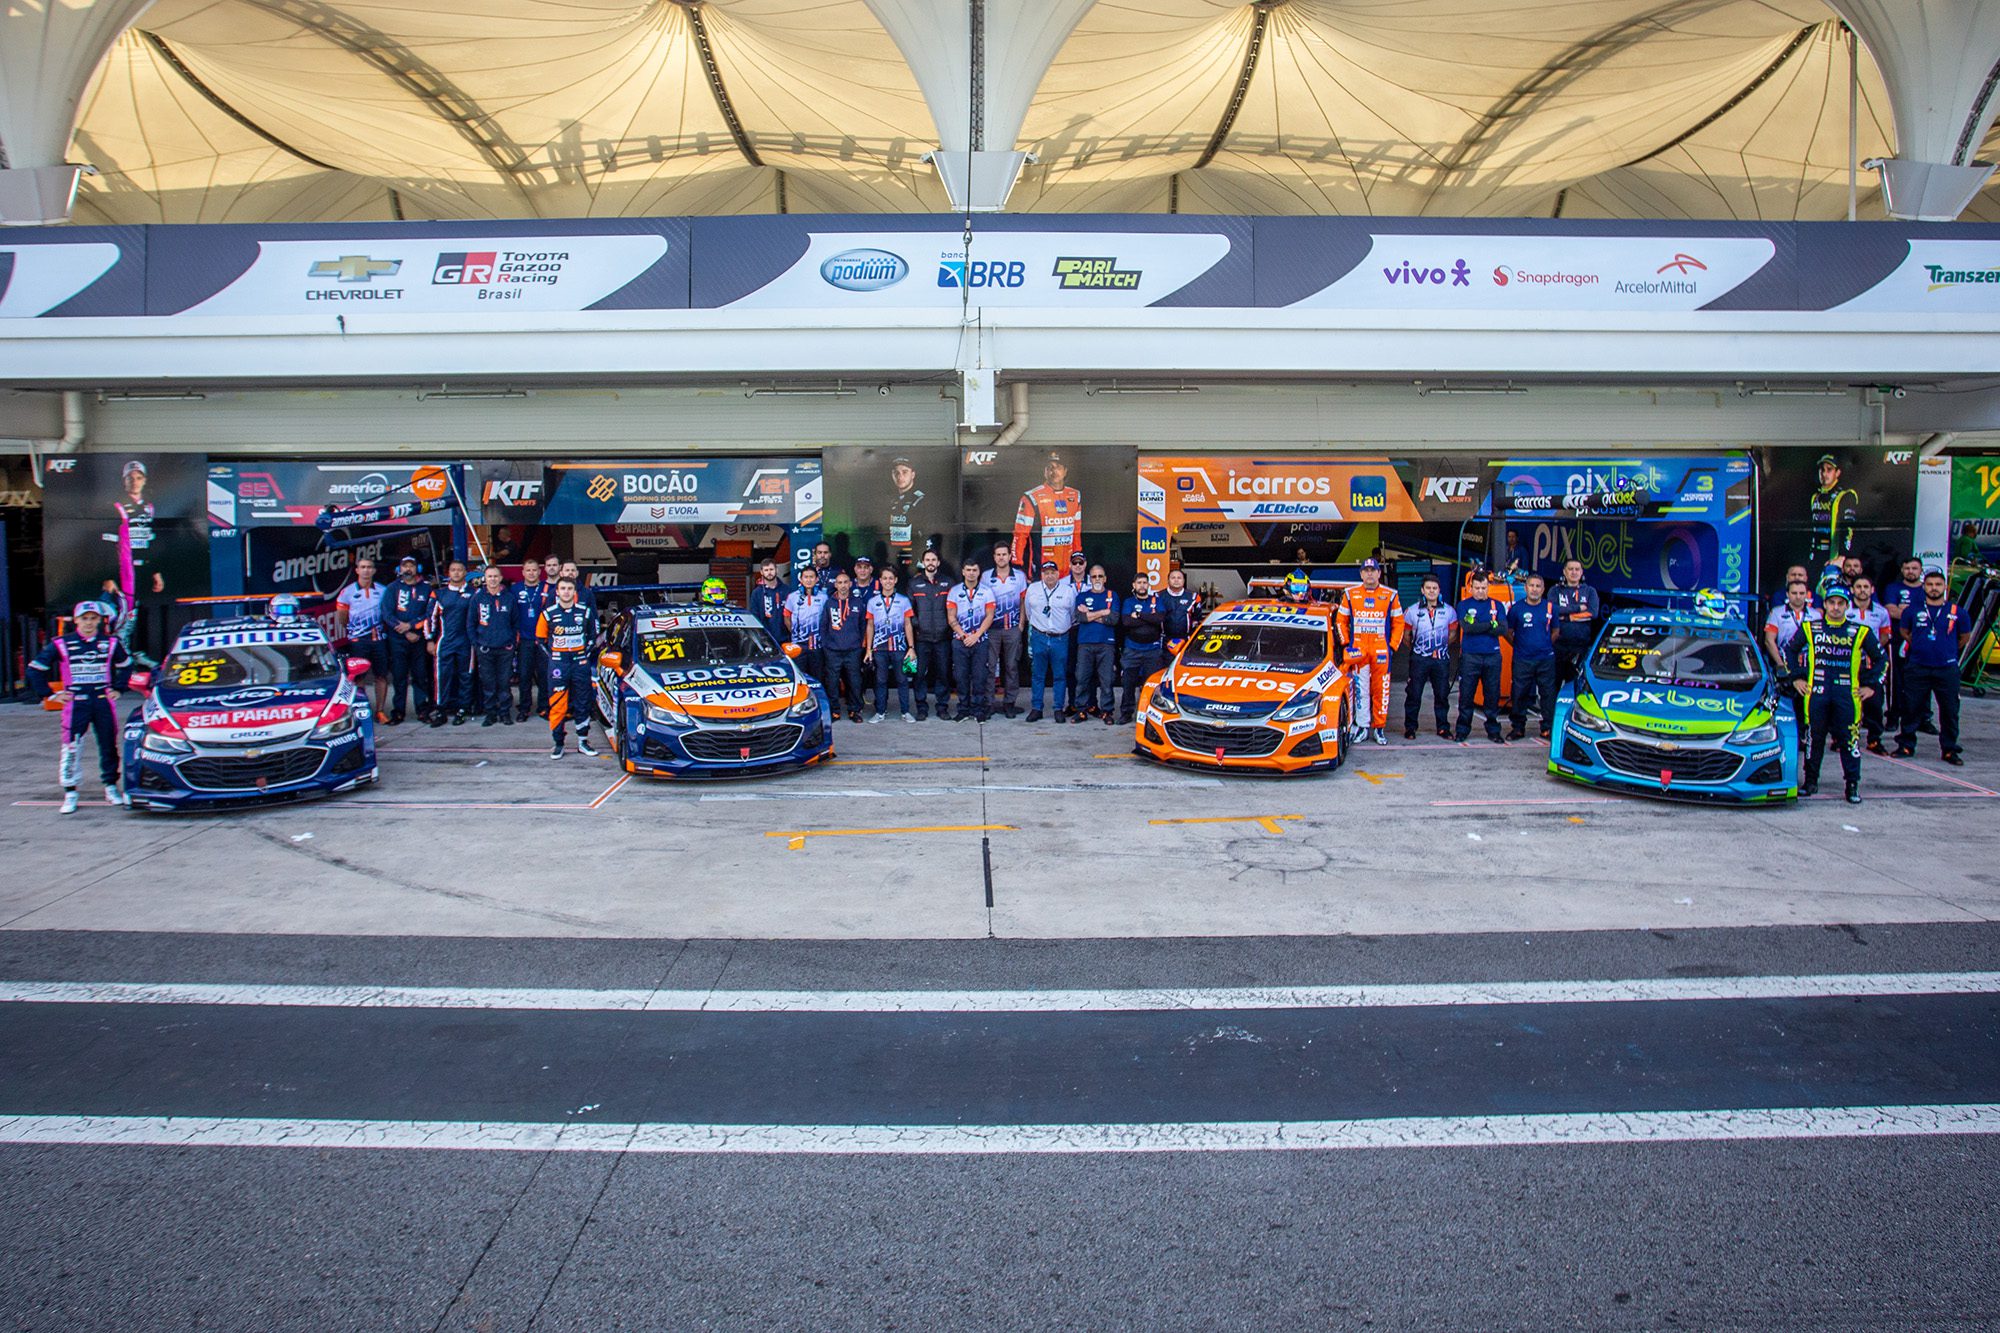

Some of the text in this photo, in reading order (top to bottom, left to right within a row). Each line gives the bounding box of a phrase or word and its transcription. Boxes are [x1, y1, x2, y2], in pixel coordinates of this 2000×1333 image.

[502, 252, 569, 261] TOYOTA
[434, 264, 492, 284] GR
[500, 263, 562, 272] GAZOO
[832, 261, 897, 284] podium
[969, 260, 1026, 288] BRB
[1069, 260, 1112, 274] PARI
[1383, 260, 1446, 285] vivo
[497, 274, 558, 285] Racing
[1076, 273, 1137, 286] MATCH
[1517, 270, 1599, 287] Snapdragon
[305, 288, 404, 301] CHEVROLET
[478, 288, 522, 300] Brasil
[1614, 281, 1697, 294] ArcelorMittal
[965, 451, 998, 465] KTF
[1884, 451, 1913, 465] KTF
[47, 459, 77, 472] KTF
[623, 470, 698, 494] BOCÃO
[758, 478, 790, 494] 121
[1228, 470, 1330, 495] icarros
[1566, 466, 1661, 495] pixbet
[1697, 475, 1714, 491] 3
[238, 482, 270, 497] 85
[482, 480, 543, 506] KTF
[1419, 477, 1478, 502] KTF
[1352, 492, 1385, 508] Itaú
[1514, 495, 1552, 509] icarros
[389, 502, 416, 520] KTF
[668, 506, 699, 515] EVORA
[1252, 503, 1319, 515] ACDelco
[740, 524, 771, 532] EVORA
[635, 538, 669, 546] PHILIPS
[1142, 540, 1165, 550] Itaú
[1533, 520, 1633, 578] pixbet
[688, 615, 745, 624] EVORA
[1218, 612, 1326, 627] ACDelco
[1354, 609, 1384, 617] icarros
[1630, 614, 1723, 627] pixbet
[181, 631, 321, 650] PHILIPS
[653, 637, 685, 645] BAPTISTA
[1814, 633, 1852, 646] pixbet
[643, 643, 685, 662] 121
[1204, 640, 1223, 654] 0
[1612, 648, 1662, 656] BAPTISTA
[1618, 654, 1637, 670] 3
[178, 665, 218, 685] 85
[660, 663, 788, 685] BOCÃO
[1316, 664, 1338, 687] ACDelco
[664, 680, 726, 692] SHOPPING
[1177, 672, 1296, 694] icarros
[701, 688, 777, 704] EVORA
[1378, 674, 1391, 715] icarros
[1205, 703, 1241, 713] CRUZE
[1601, 688, 1744, 717] pixbet
[723, 706, 758, 715] CRUZE
[188, 708, 293, 728] SEM PARAR
[1646, 721, 1688, 732] CRUZE
[230, 729, 274, 739] CRUZE
[325, 733, 358, 748] PHILIPS
[141, 751, 176, 765] PHILIPS
